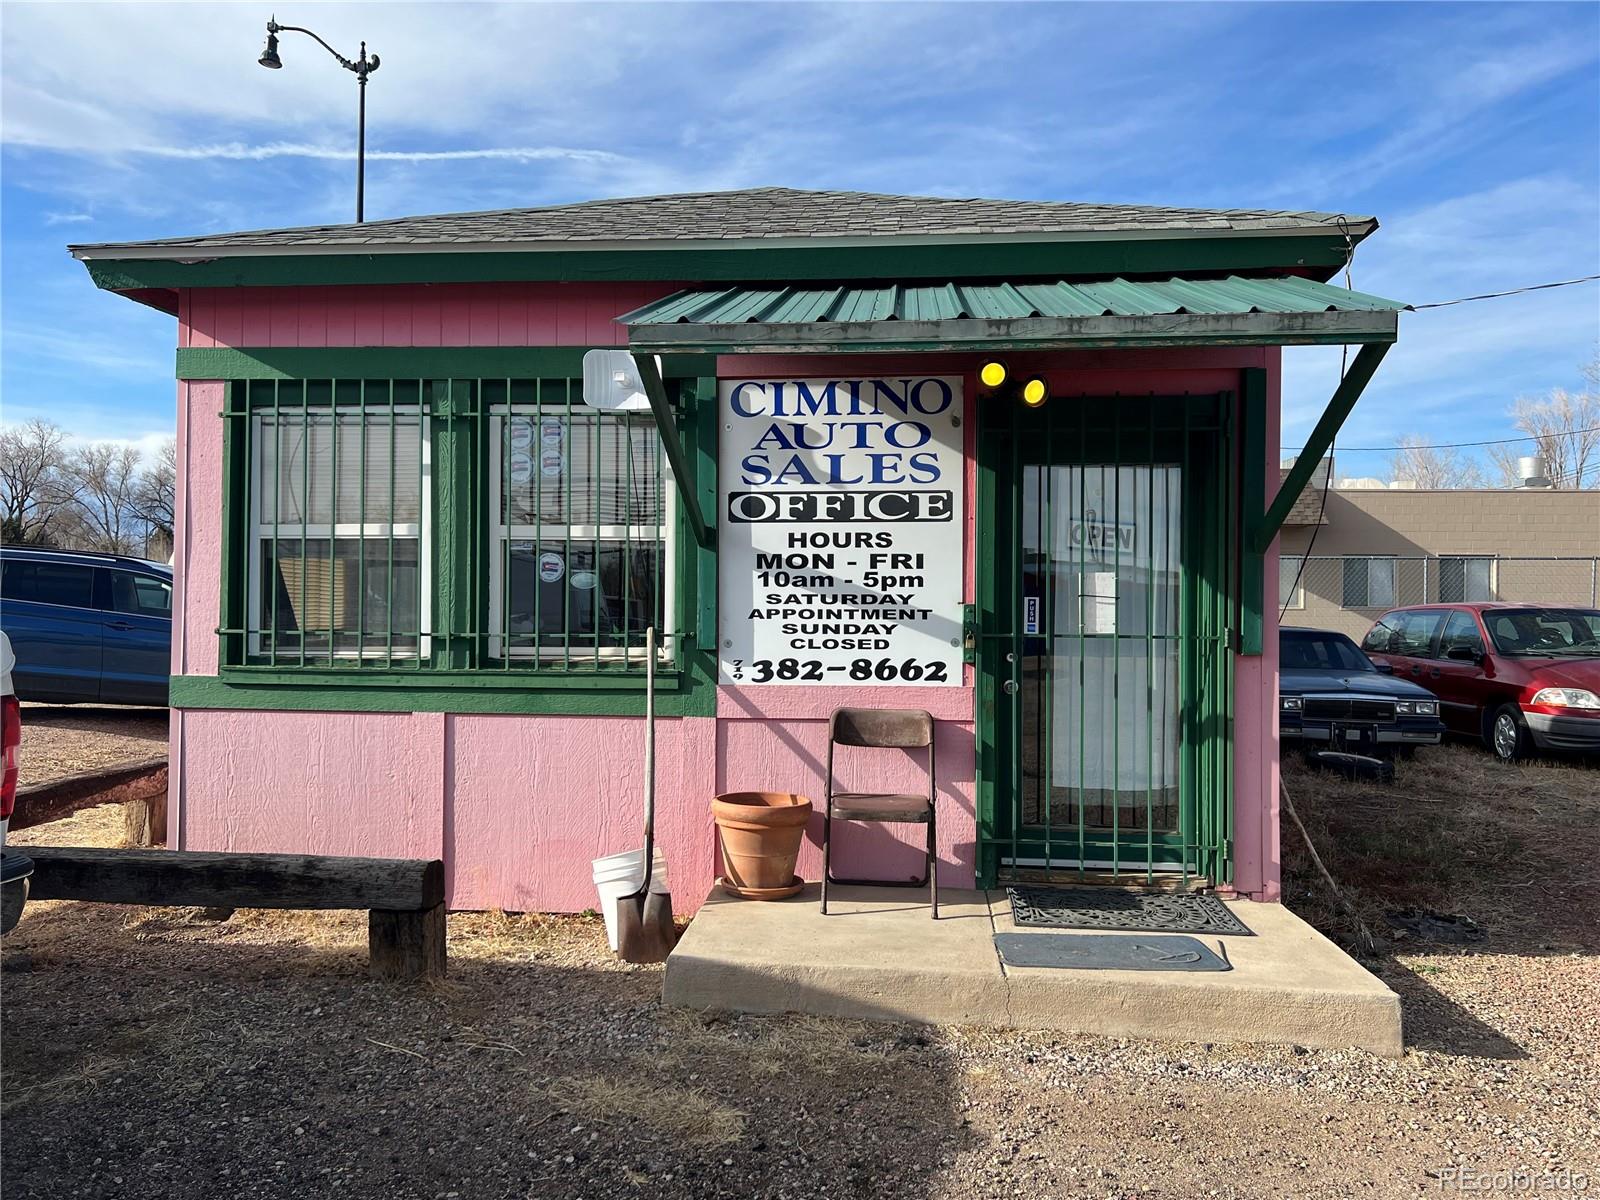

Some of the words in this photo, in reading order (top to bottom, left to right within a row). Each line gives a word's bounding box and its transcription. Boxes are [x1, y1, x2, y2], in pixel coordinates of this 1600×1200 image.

[730, 378, 952, 418] CIMINO
[750, 421, 932, 450] AUTO
[741, 452, 941, 485] SALES
[730, 491, 951, 521] OFFICE
[788, 532, 893, 549] HOURS
[1072, 523, 1132, 549] OPEN
[756, 553, 834, 570] MON
[869, 553, 924, 570] FRI
[757, 571, 834, 588] 10am
[863, 571, 924, 591] 5pm
[765, 593, 915, 605] SATURDAY
[748, 608, 933, 620] APPOINTMENT
[781, 623, 899, 635] SUNDAY
[790, 638, 890, 650] CLOSED
[732, 659, 744, 680] 719
[751, 658, 948, 683] 382-8662
